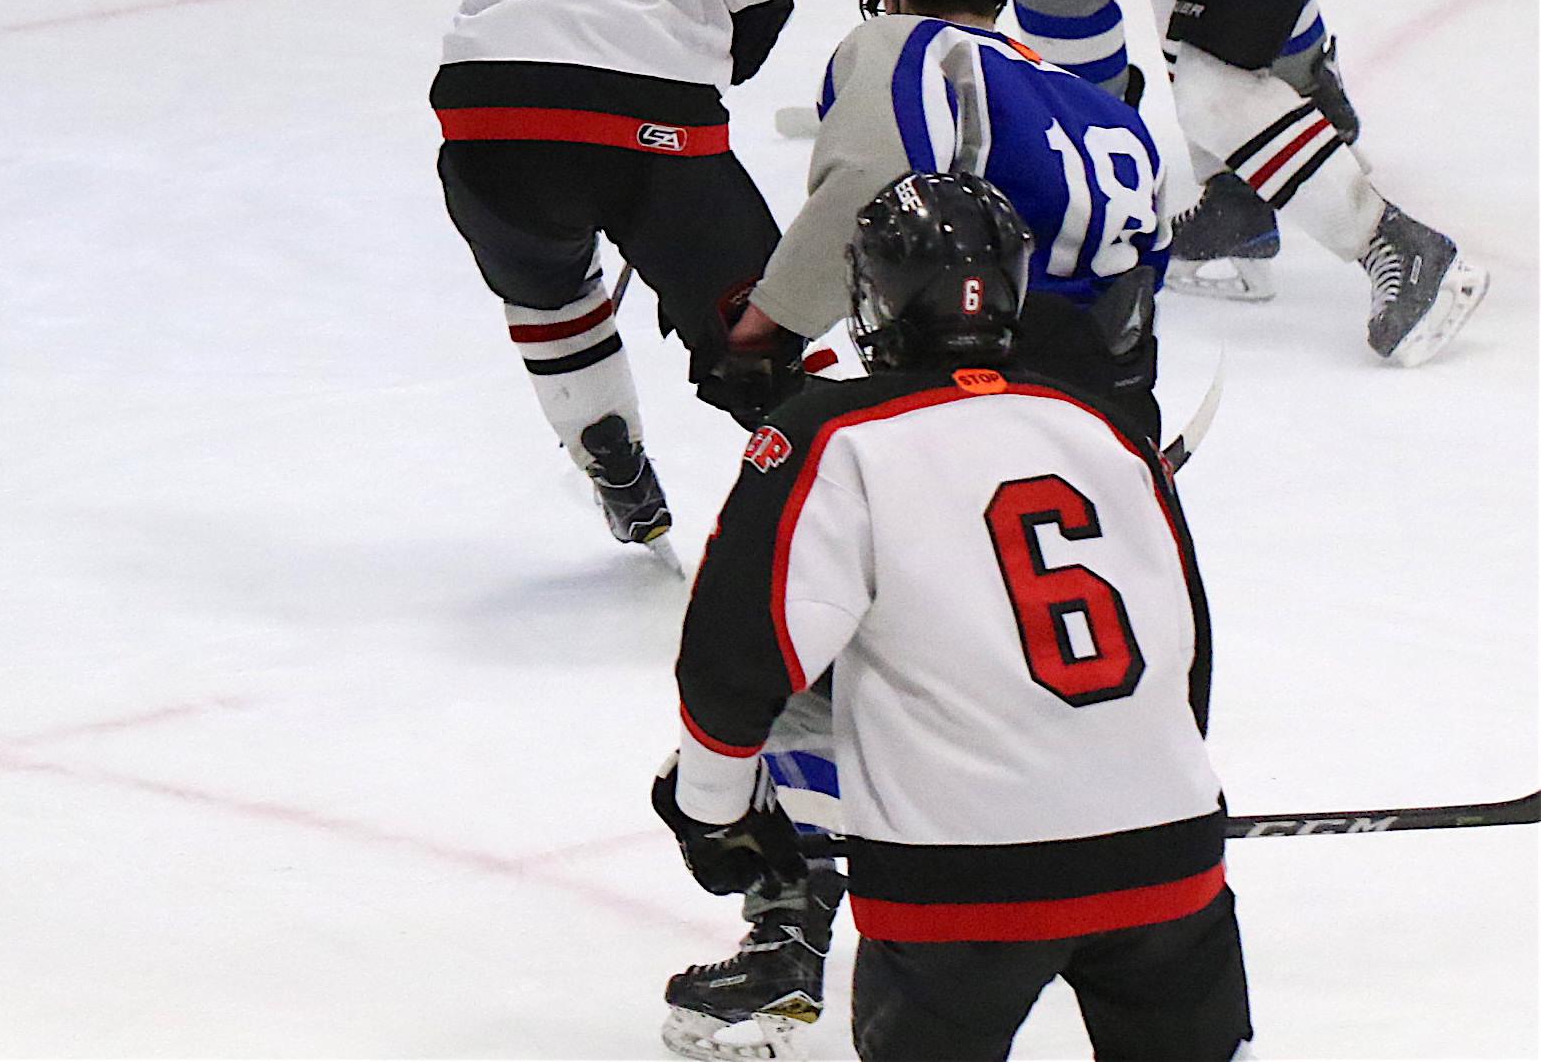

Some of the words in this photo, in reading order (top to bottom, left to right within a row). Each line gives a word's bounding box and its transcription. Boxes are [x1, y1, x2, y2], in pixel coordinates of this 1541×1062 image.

[1044, 116, 1157, 279] 18
[963, 276, 983, 315] 6
[957, 372, 1000, 388] STOP
[984, 473, 1146, 708] 6
